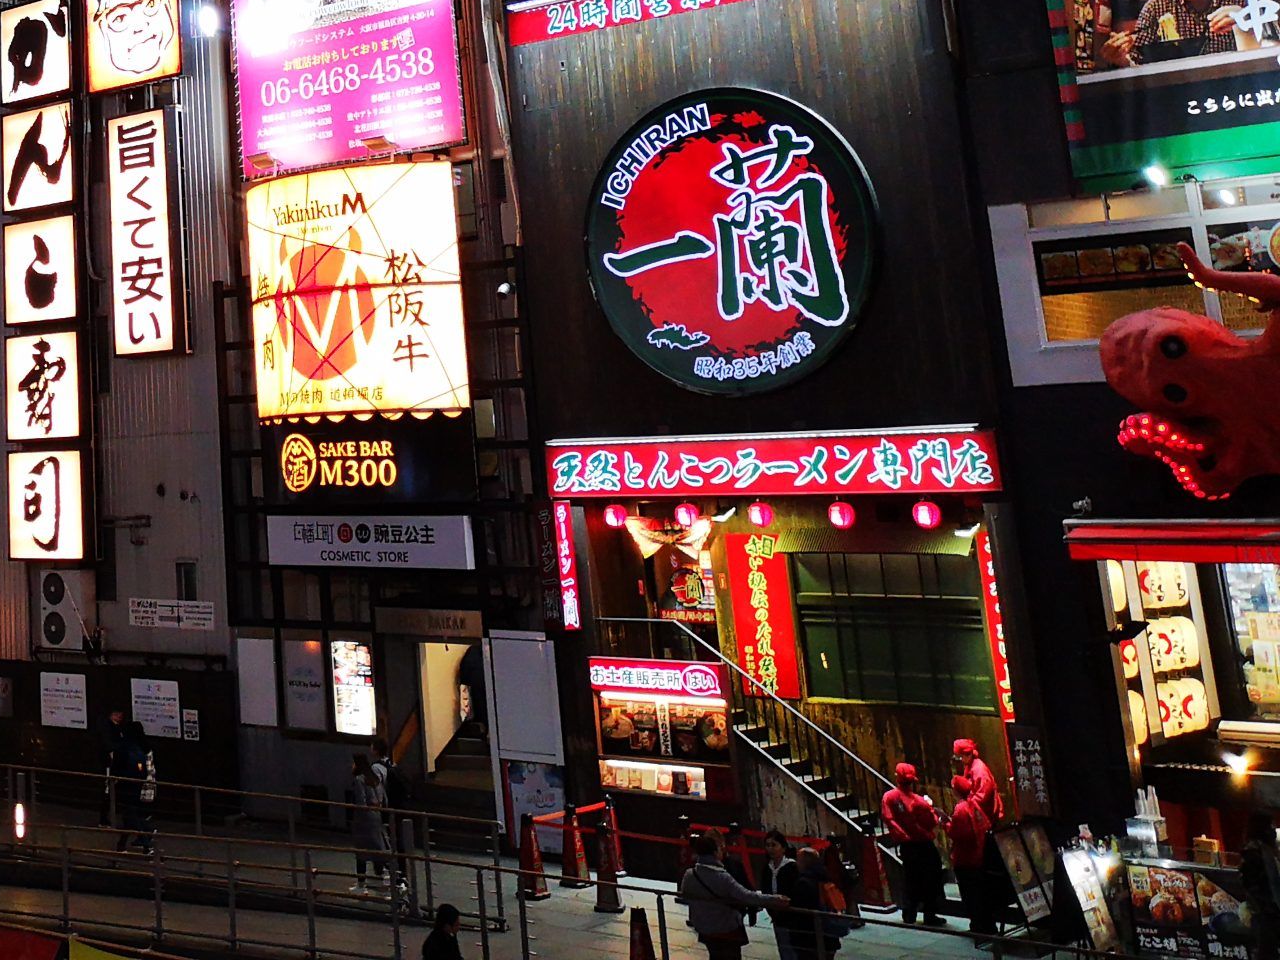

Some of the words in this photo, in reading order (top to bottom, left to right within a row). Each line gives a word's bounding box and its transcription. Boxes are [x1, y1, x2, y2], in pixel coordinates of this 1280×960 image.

[260, 47, 435, 108] 06-6468-4538
[1186, 89, 1280, 116] こちらに出
[600, 102, 712, 210] ICHIRAN
[117, 119, 166, 346] 旨くて安い
[272, 199, 340, 227] Yakiniku
[341, 192, 368, 216] M
[603, 126, 850, 326] 一蘭
[383, 248, 431, 374] 松阪牛
[318, 441, 358, 458] SAKE
[360, 441, 395, 458] BAR
[319, 459, 398, 488] M300
[552, 437, 995, 493] 天然とんこつラーメン専門店
[320, 550, 372, 563] COSMETIC
[377, 551, 410, 563] STORE
[556, 503, 581, 629] ラーメン一蘭
[590, 664, 681, 685] お土産販売所
[686, 668, 717, 690] はい
